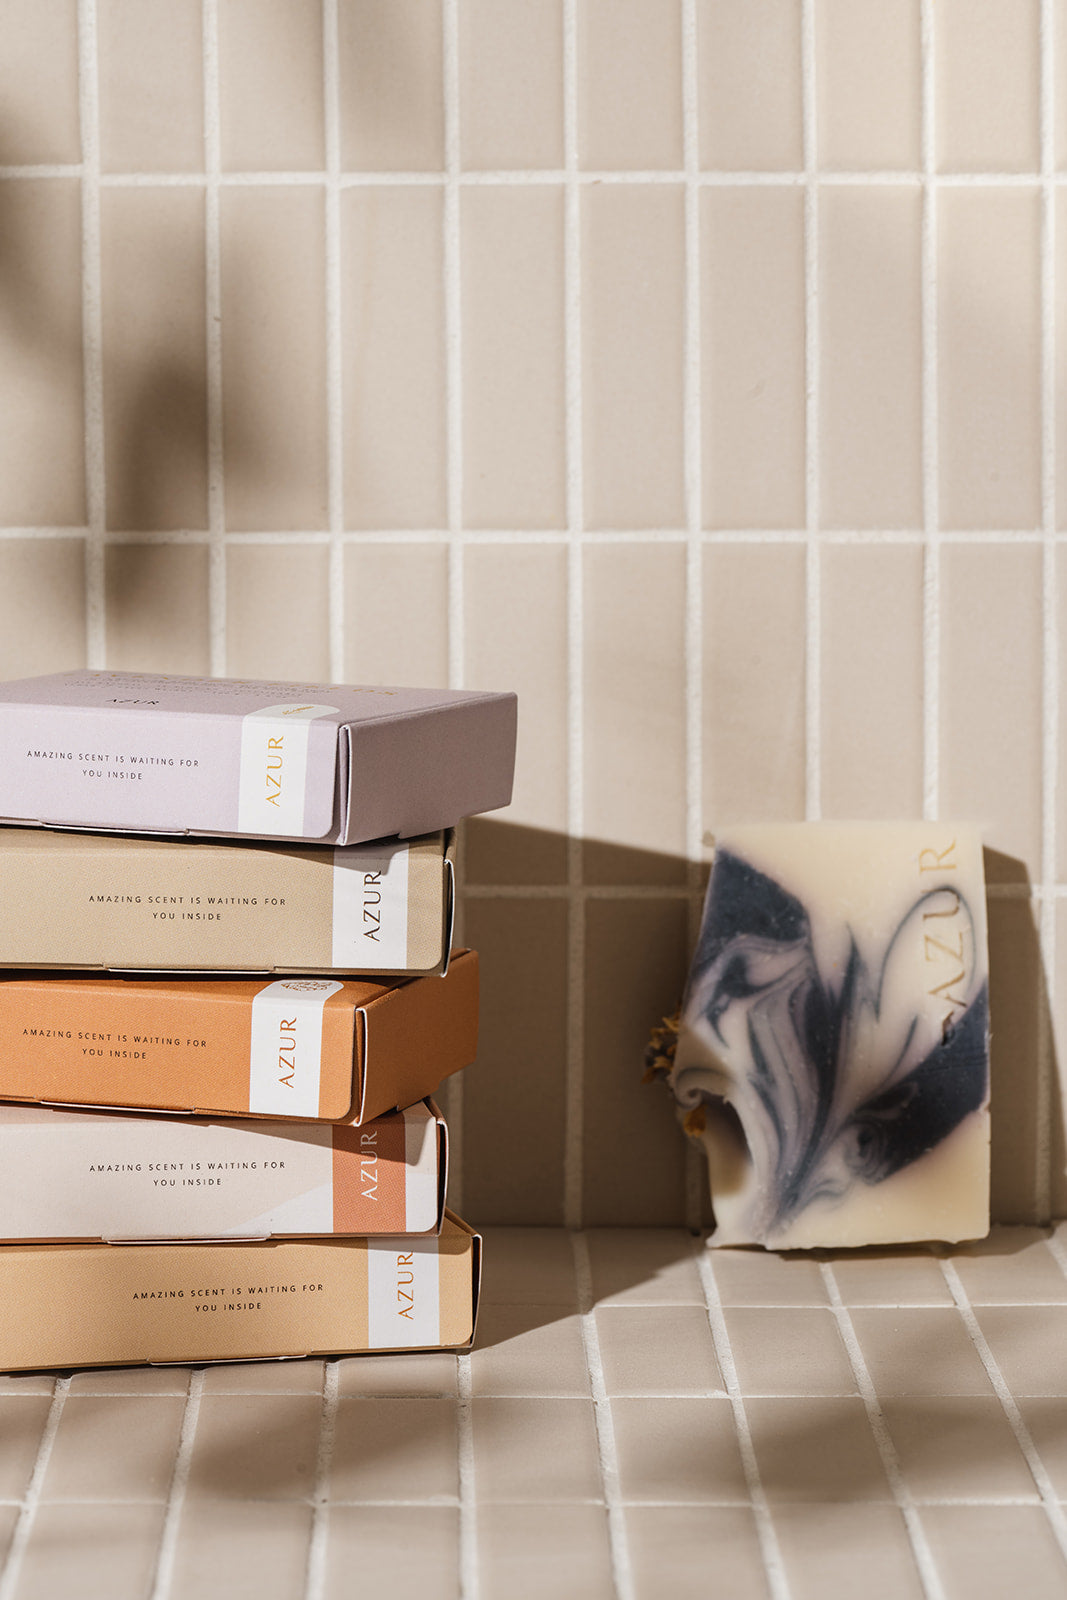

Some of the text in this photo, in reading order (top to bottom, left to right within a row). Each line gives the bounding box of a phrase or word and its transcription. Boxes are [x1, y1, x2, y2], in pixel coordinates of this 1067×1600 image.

[27, 750, 199, 767] AMAZING SCENT IS WAITING FOR
[82, 769, 142, 780] YOU INSIDE
[265, 735, 284, 807] AZUR
[88, 895, 286, 906] AMAZING SCENT IS WAITING FOR
[363, 869, 382, 942] AZUR
[152, 912, 221, 921] YOU INSIDE
[918, 837, 967, 1009] AZUR
[22, 1028, 207, 1048] AMAZING SCENT IS WAITING FOR
[82, 1048, 146, 1060] YOU INSIDE
[278, 1016, 297, 1088] AZUR
[89, 1160, 286, 1172] AMAZING SCENT IS WAITING FOR
[360, 1130, 378, 1201] AZUR
[153, 1178, 221, 1187] YOU INSIDE
[132, 1283, 323, 1300] AMAZING SCENT IS WAITING FOR
[397, 1250, 414, 1320] AZUR
[195, 1302, 261, 1312] YOU INSIDE
